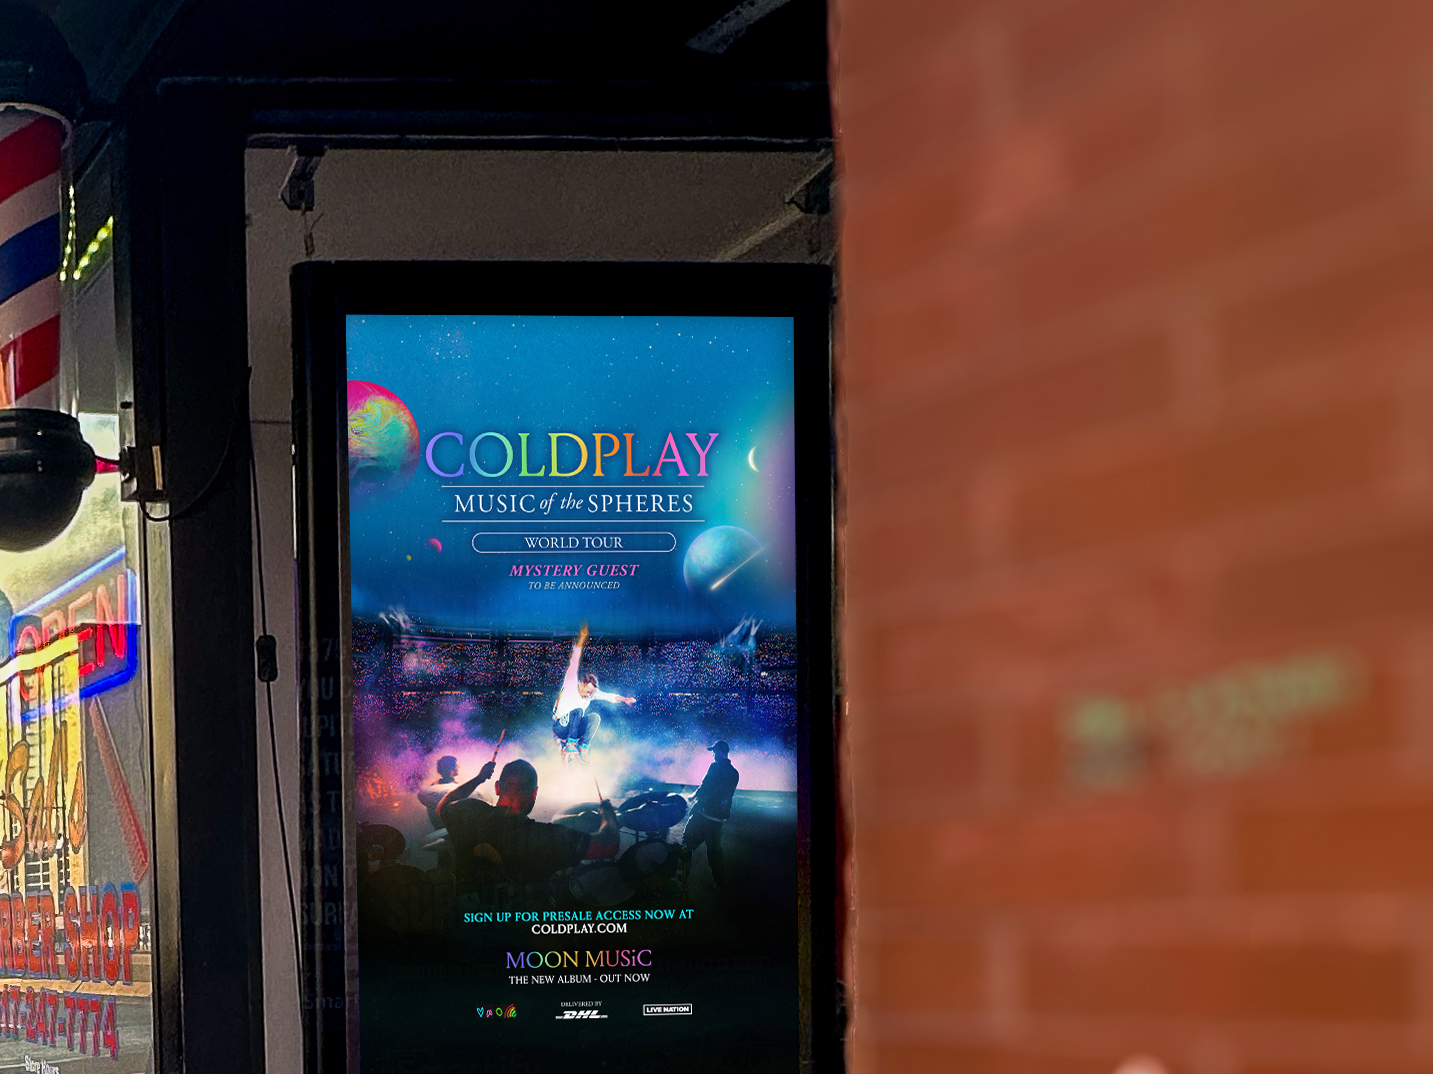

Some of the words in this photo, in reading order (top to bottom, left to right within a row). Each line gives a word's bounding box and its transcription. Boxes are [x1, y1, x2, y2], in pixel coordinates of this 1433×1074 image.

[426, 431, 719, 478] COLDPLAY
[455, 494, 535, 513] MUSIC
[539, 491, 558, 515] of
[560, 492, 584, 510] the
[587, 493, 694, 513] SPHERES
[524, 537, 580, 549] WORLD
[582, 537, 624, 549] TOUR
[508, 564, 583, 577] MYSTERY
[586, 564, 640, 577] GUEST
[528, 581, 542, 590] TO
[544, 581, 556, 590] BE
[558, 581, 621, 590] ANNOUNCED
[15, 573, 127, 703] OPEN
[463, 912, 493, 923] SIGN
[496, 912, 512, 922] UP
[515, 911, 540, 922] FOR
[542, 911, 593, 921] PRESALE
[595, 910, 642, 921] ACCESS
[644, 909, 675, 920] NOW
[678, 909, 695, 920] AT
[63, 881, 140, 986] SHOP
[531, 923, 628, 935] COLDPLAY.COM
[506, 950, 579, 969] MOON
[509, 975, 529, 985] THE
[531, 975, 555, 984] NEW
[557, 974, 592, 984] ALBUM
[599, 974, 621, 983] OUT
[624, 973, 651, 983] NOW
[563, 1010, 602, 1019] DHL
[663, 1005, 690, 1013] NATION
